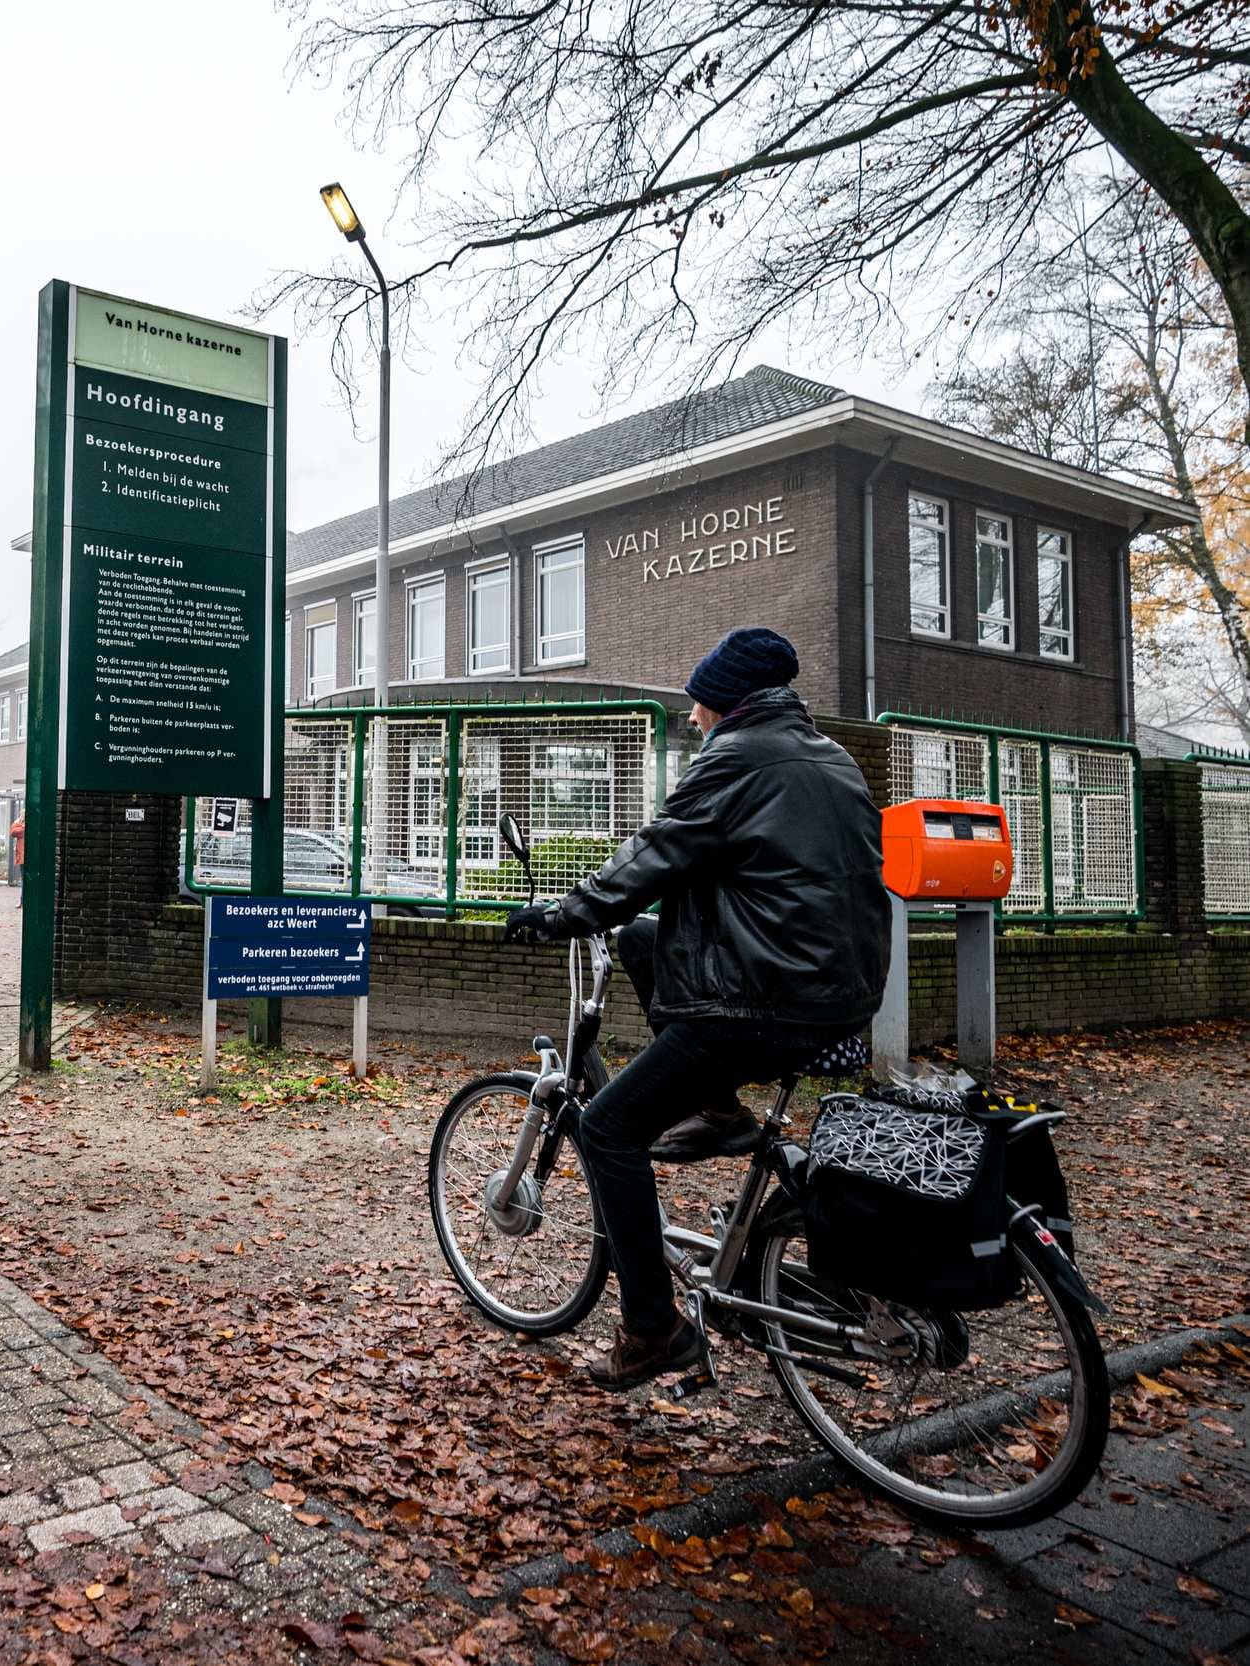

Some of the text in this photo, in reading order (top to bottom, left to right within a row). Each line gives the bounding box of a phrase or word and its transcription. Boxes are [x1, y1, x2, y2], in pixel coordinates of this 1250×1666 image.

[105, 312, 242, 355] Van Horne kazerne
[87, 383, 224, 431] Hoofdingang
[86, 434, 221, 469] Bezoekersprocedure
[103, 461, 230, 494] 1. Melden bij de wacht
[102, 481, 221, 512] 2. Identificatieplicht
[606, 496, 783, 559] VAN HORNE
[83, 543, 183, 568] Militair terrein
[643, 528, 796, 583] KAZERNE
[99, 568, 132, 580] Verboden
[163, 578, 188, 588] Behalve
[190, 582, 203, 590] met
[205, 584, 245, 597] toestemming
[113, 580, 121, 588] de
[123, 582, 174, 595] rechthebbende.
[99, 589, 112, 597] Aan
[124, 593, 167, 605] toestemming
[196, 602, 212, 610] geval
[98, 599, 123, 608] waarde
[186, 610, 194, 618] op
[207, 612, 229, 621] terrein
[98, 608, 119, 617] dende
[120, 611, 140, 620] regels
[158, 615, 193, 627] betrekking
[207, 620, 217, 628] het
[106, 618, 120, 627] acht
[122, 621, 148, 630] worden
[184, 627, 192, 636] Bij
[193, 629, 223, 639] handelen
[232, 632, 249, 642] strijd
[113, 629, 129, 637] deze
[131, 632, 150, 640] regels
[153, 633, 164, 641] kan
[166, 636, 188, 644] proces
[190, 637, 213, 647] verbaal
[215, 640, 240, 649] worden
[96, 655, 108, 664] Op
[121, 658, 144, 667] terrein
[146, 661, 158, 670] zijn
[160, 662, 168, 670] de
[170, 662, 205, 674] bepalingen
[220, 667, 228, 675] de
[96, 666, 159, 680] verkeerswetgeving
[174, 673, 230, 686] overeenkomstige
[96, 676, 132, 687] toepassing
[149, 680, 163, 688] dien
[165, 682, 197, 691] verstande
[95, 694, 103, 702] A.
[110, 695, 120, 703] De
[122, 697, 154, 706] maximum
[156, 699, 184, 708] snelheid
[195, 703, 212, 711] km/u
[110, 714, 140, 723] Parkeren
[142, 717, 163, 726] buiten
[165, 718, 173, 726] de
[175, 719, 220, 730] parkeerplaats
[110, 724, 130, 733] boden
[95, 742, 103, 750] C.
[109, 743, 173, 755] Vergunninghouders
[175, 747, 205, 757] parkeren
[207, 750, 215, 758] op
[226, 905, 357, 916] Bezoekers en leveranciers
[268, 918, 317, 928] azc Weert
[242, 947, 339, 958] Parkeren bezoekers
[218, 976, 255, 984] verboden
[258, 975, 289, 985] toegang
[311, 973, 360, 982] onbevoegden
